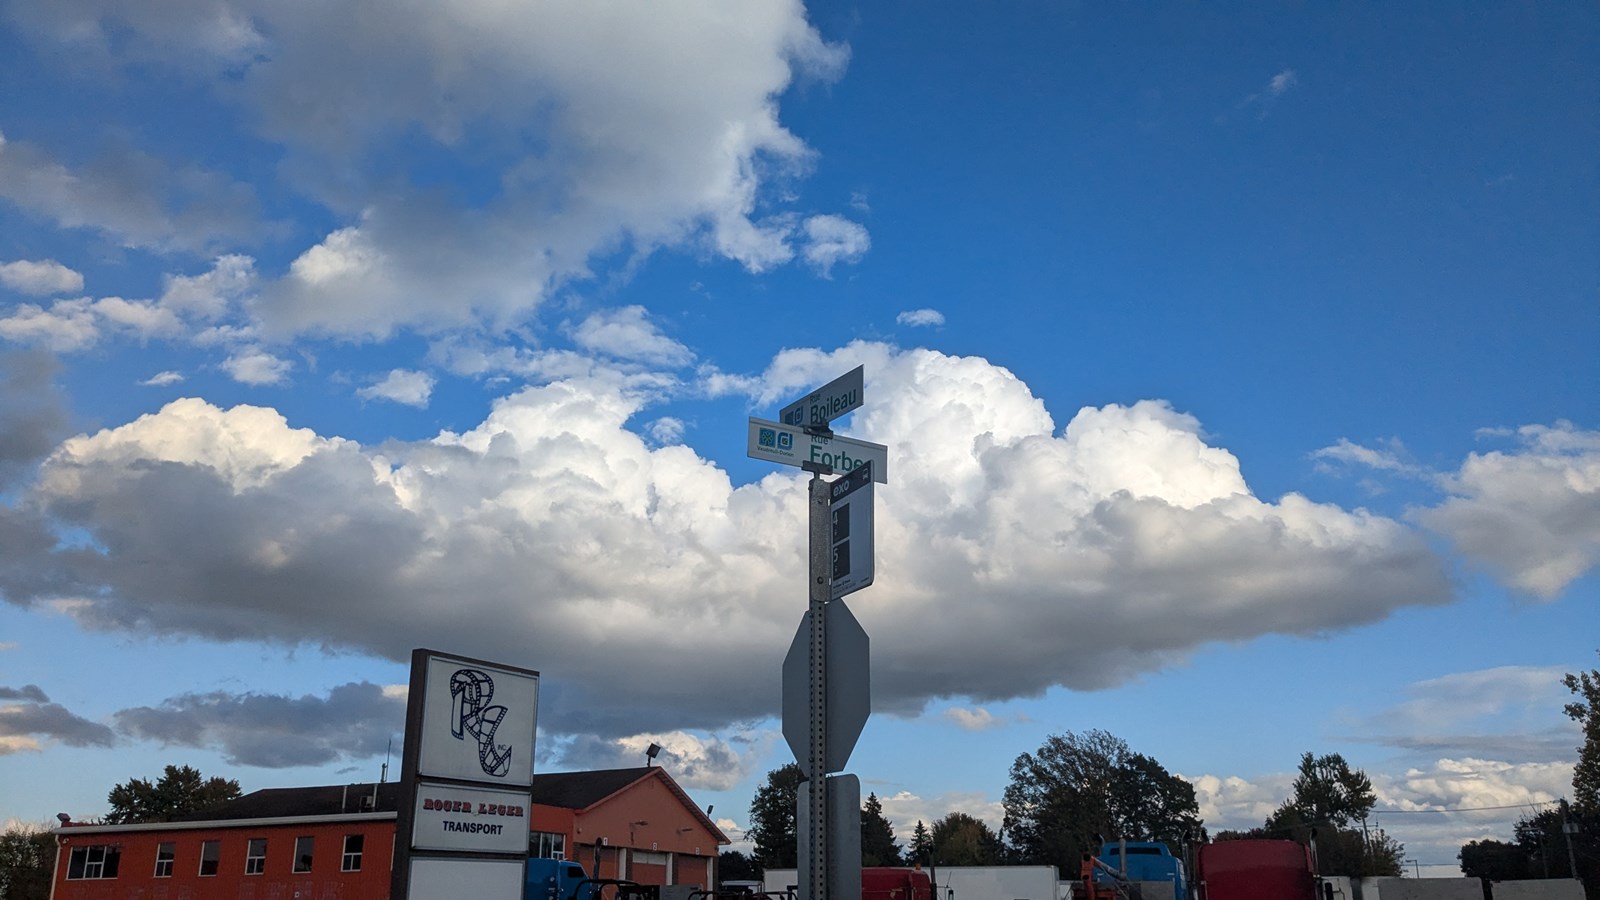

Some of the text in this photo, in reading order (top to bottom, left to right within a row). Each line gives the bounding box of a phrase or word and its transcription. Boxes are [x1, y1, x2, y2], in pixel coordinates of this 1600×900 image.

[810, 393, 821, 405] Rue
[810, 389, 857, 424] Boileau
[811, 434, 829, 445] Rue
[810, 444, 864, 471] Forbe
[834, 480, 850, 497] exo
[833, 511, 838, 526] 4
[833, 548, 839, 563] 5
[423, 798, 524, 817] ROGER LEGER
[442, 820, 503, 835] TRANSPORT
